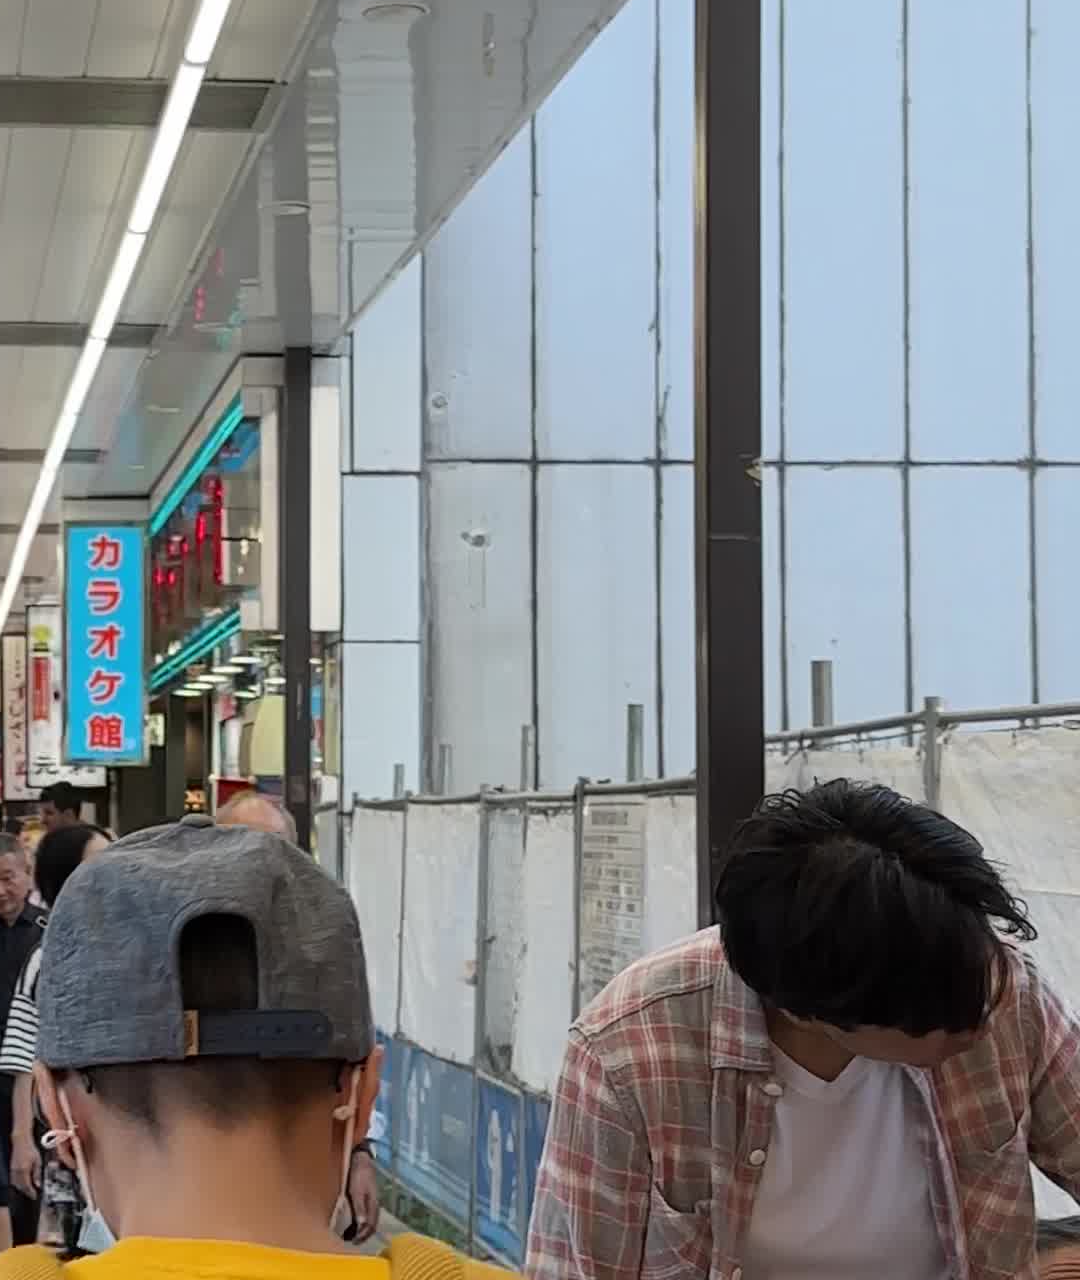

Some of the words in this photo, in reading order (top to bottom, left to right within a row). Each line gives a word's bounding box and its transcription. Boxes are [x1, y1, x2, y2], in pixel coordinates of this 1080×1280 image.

[87, 534, 123, 751] カラオケ館
